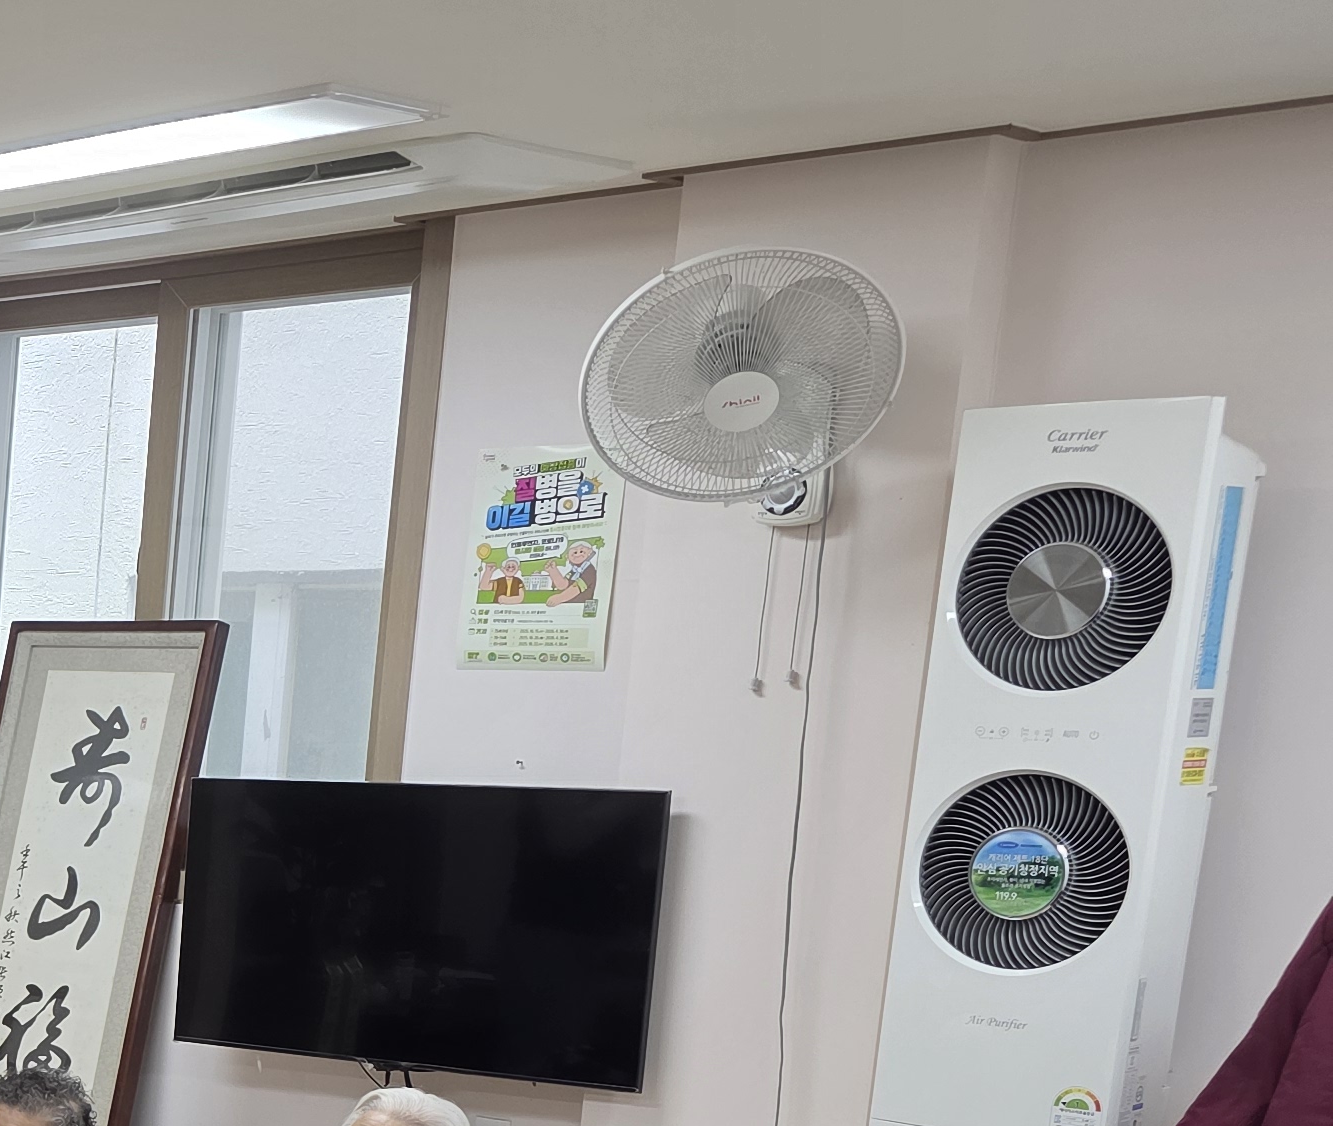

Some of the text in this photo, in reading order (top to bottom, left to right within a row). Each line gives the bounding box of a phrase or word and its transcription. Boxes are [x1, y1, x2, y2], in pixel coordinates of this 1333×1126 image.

[1047, 429, 1109, 442] Carrier
[514, 464, 538, 477] 모두의
[514, 470, 585, 503] 질병을
[486, 501, 532, 531] 이길
[534, 492, 607, 526] 병으로
[977, 863, 1059, 877] 안심 공기청정지역
[995, 891, 1018, 901] 119.9
[965, 1015, 1029, 1032] Air Purifier
